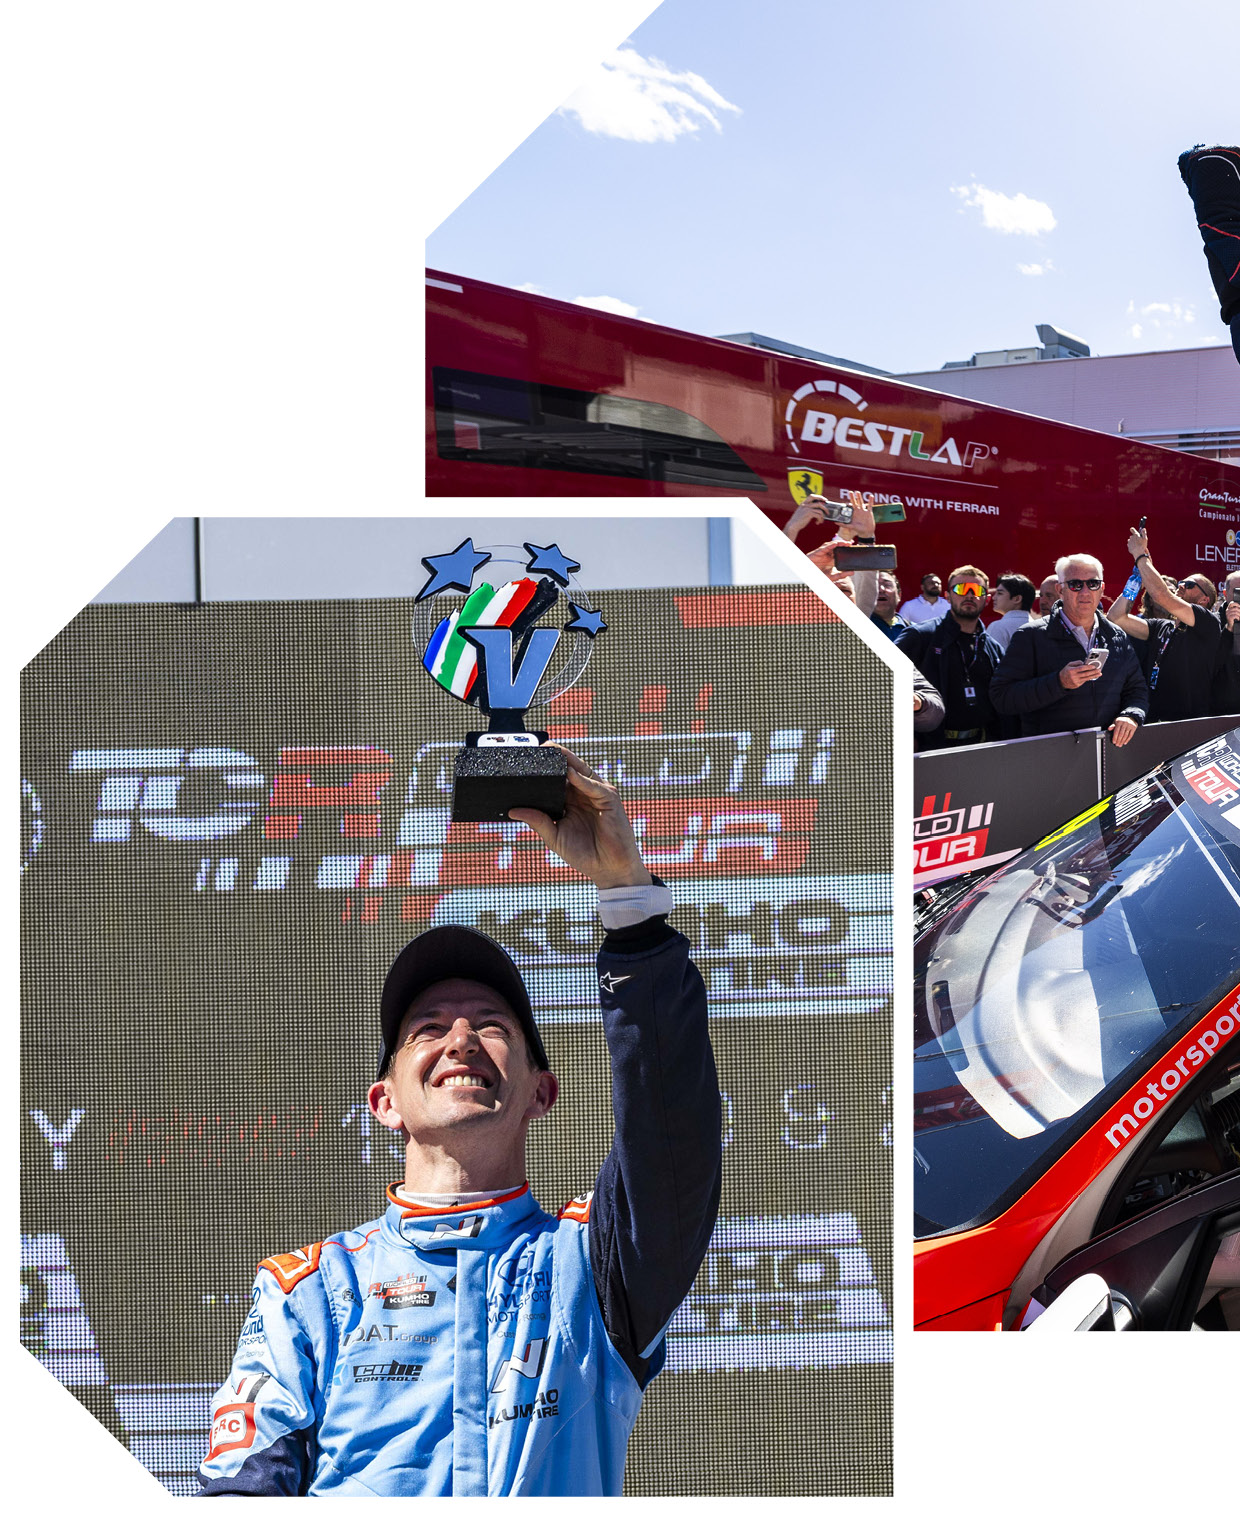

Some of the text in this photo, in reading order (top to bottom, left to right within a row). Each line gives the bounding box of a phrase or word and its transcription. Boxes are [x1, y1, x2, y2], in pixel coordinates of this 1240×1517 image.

[904, 496, 944, 510] WITH
[946, 501, 1000, 516] FERRARI
[1198, 508, 1236, 522] Campionato
[1193, 769, 1240, 808] TOUR
[389, 1284, 424, 1296] TOUR
[389, 1293, 430, 1304] KUMHO
[400, 1332, 439, 1345] Group
